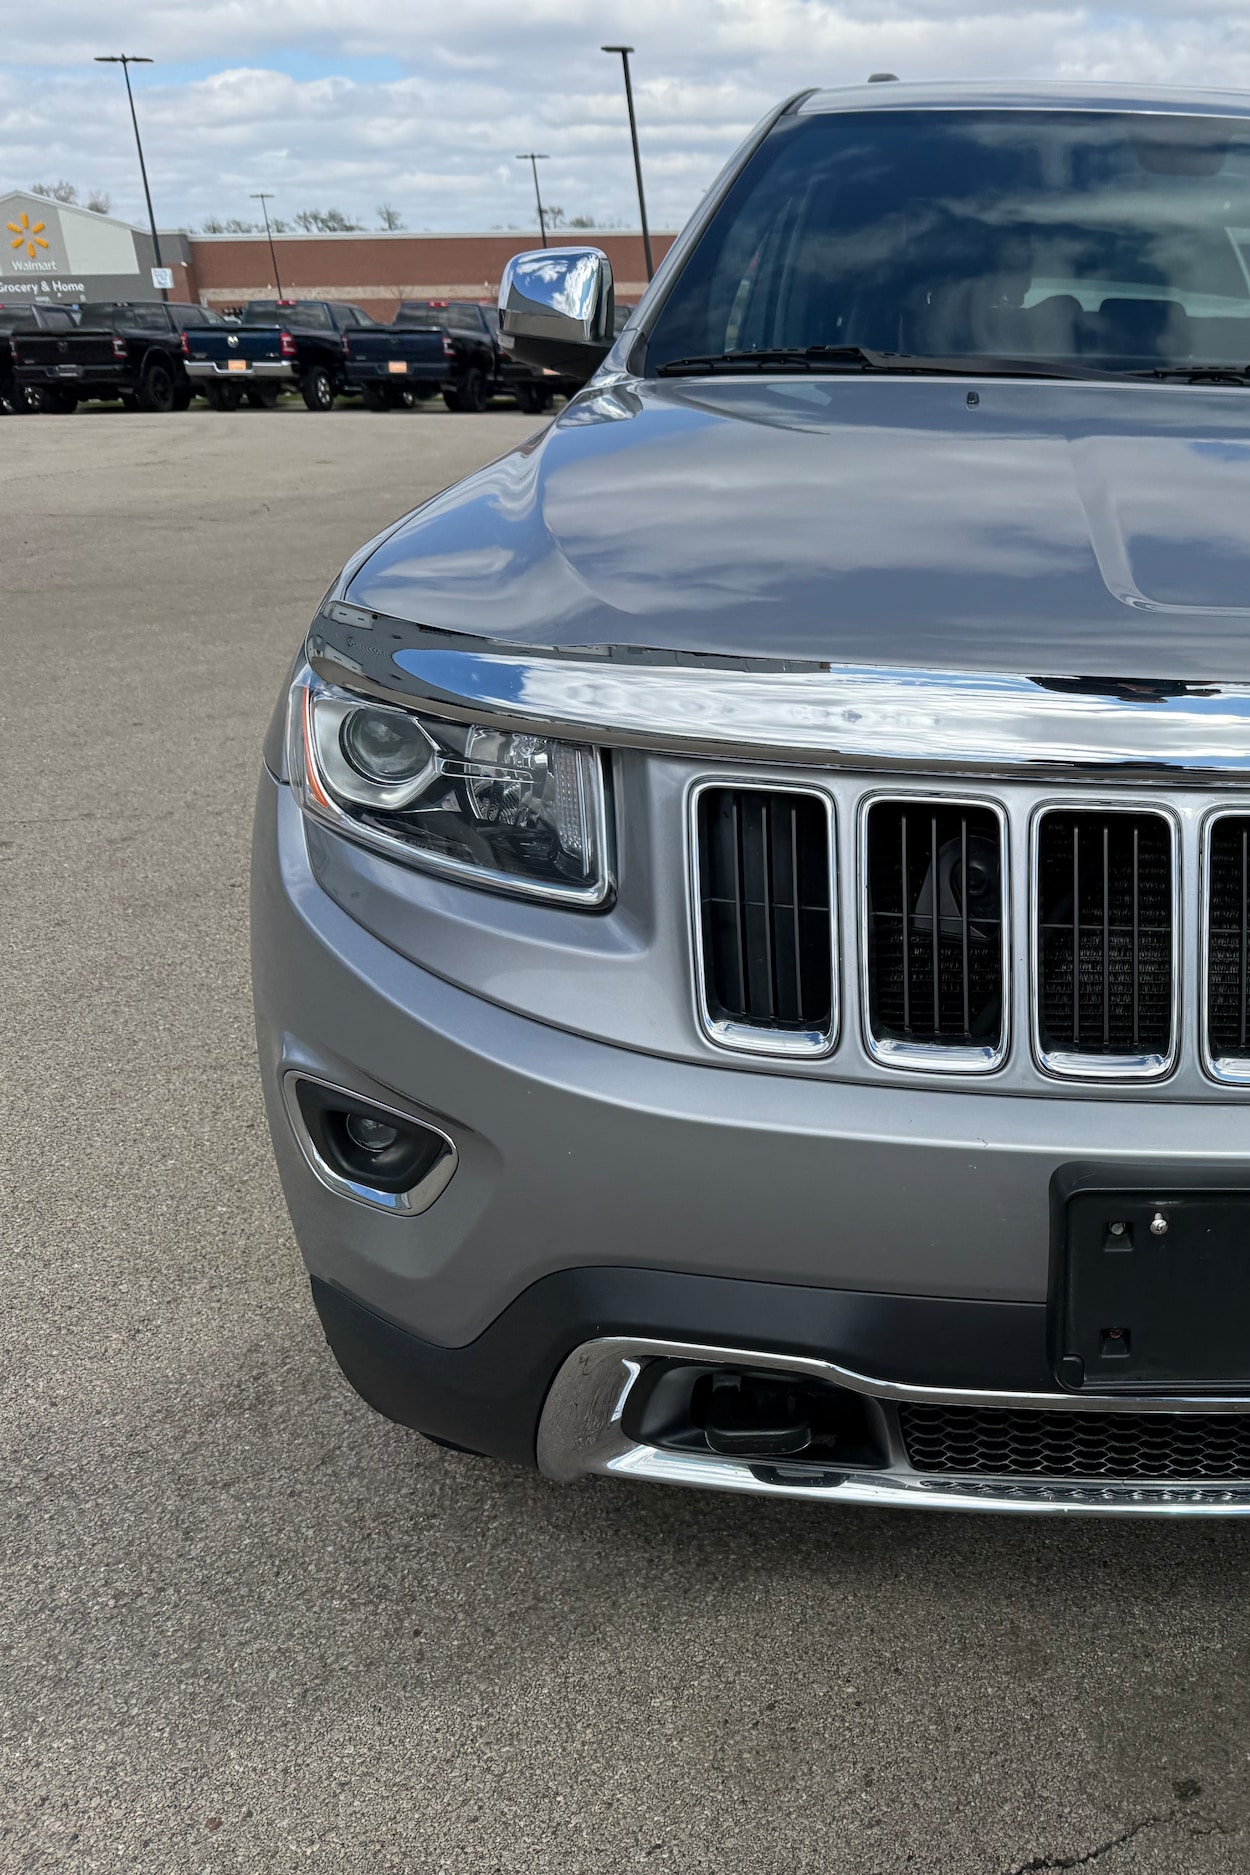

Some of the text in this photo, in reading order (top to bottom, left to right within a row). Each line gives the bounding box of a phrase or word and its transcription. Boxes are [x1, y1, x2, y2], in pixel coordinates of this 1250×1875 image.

[12, 260, 57, 271] Walmart
[41, 280, 50, 292] &
[52, 280, 84, 292] Home
